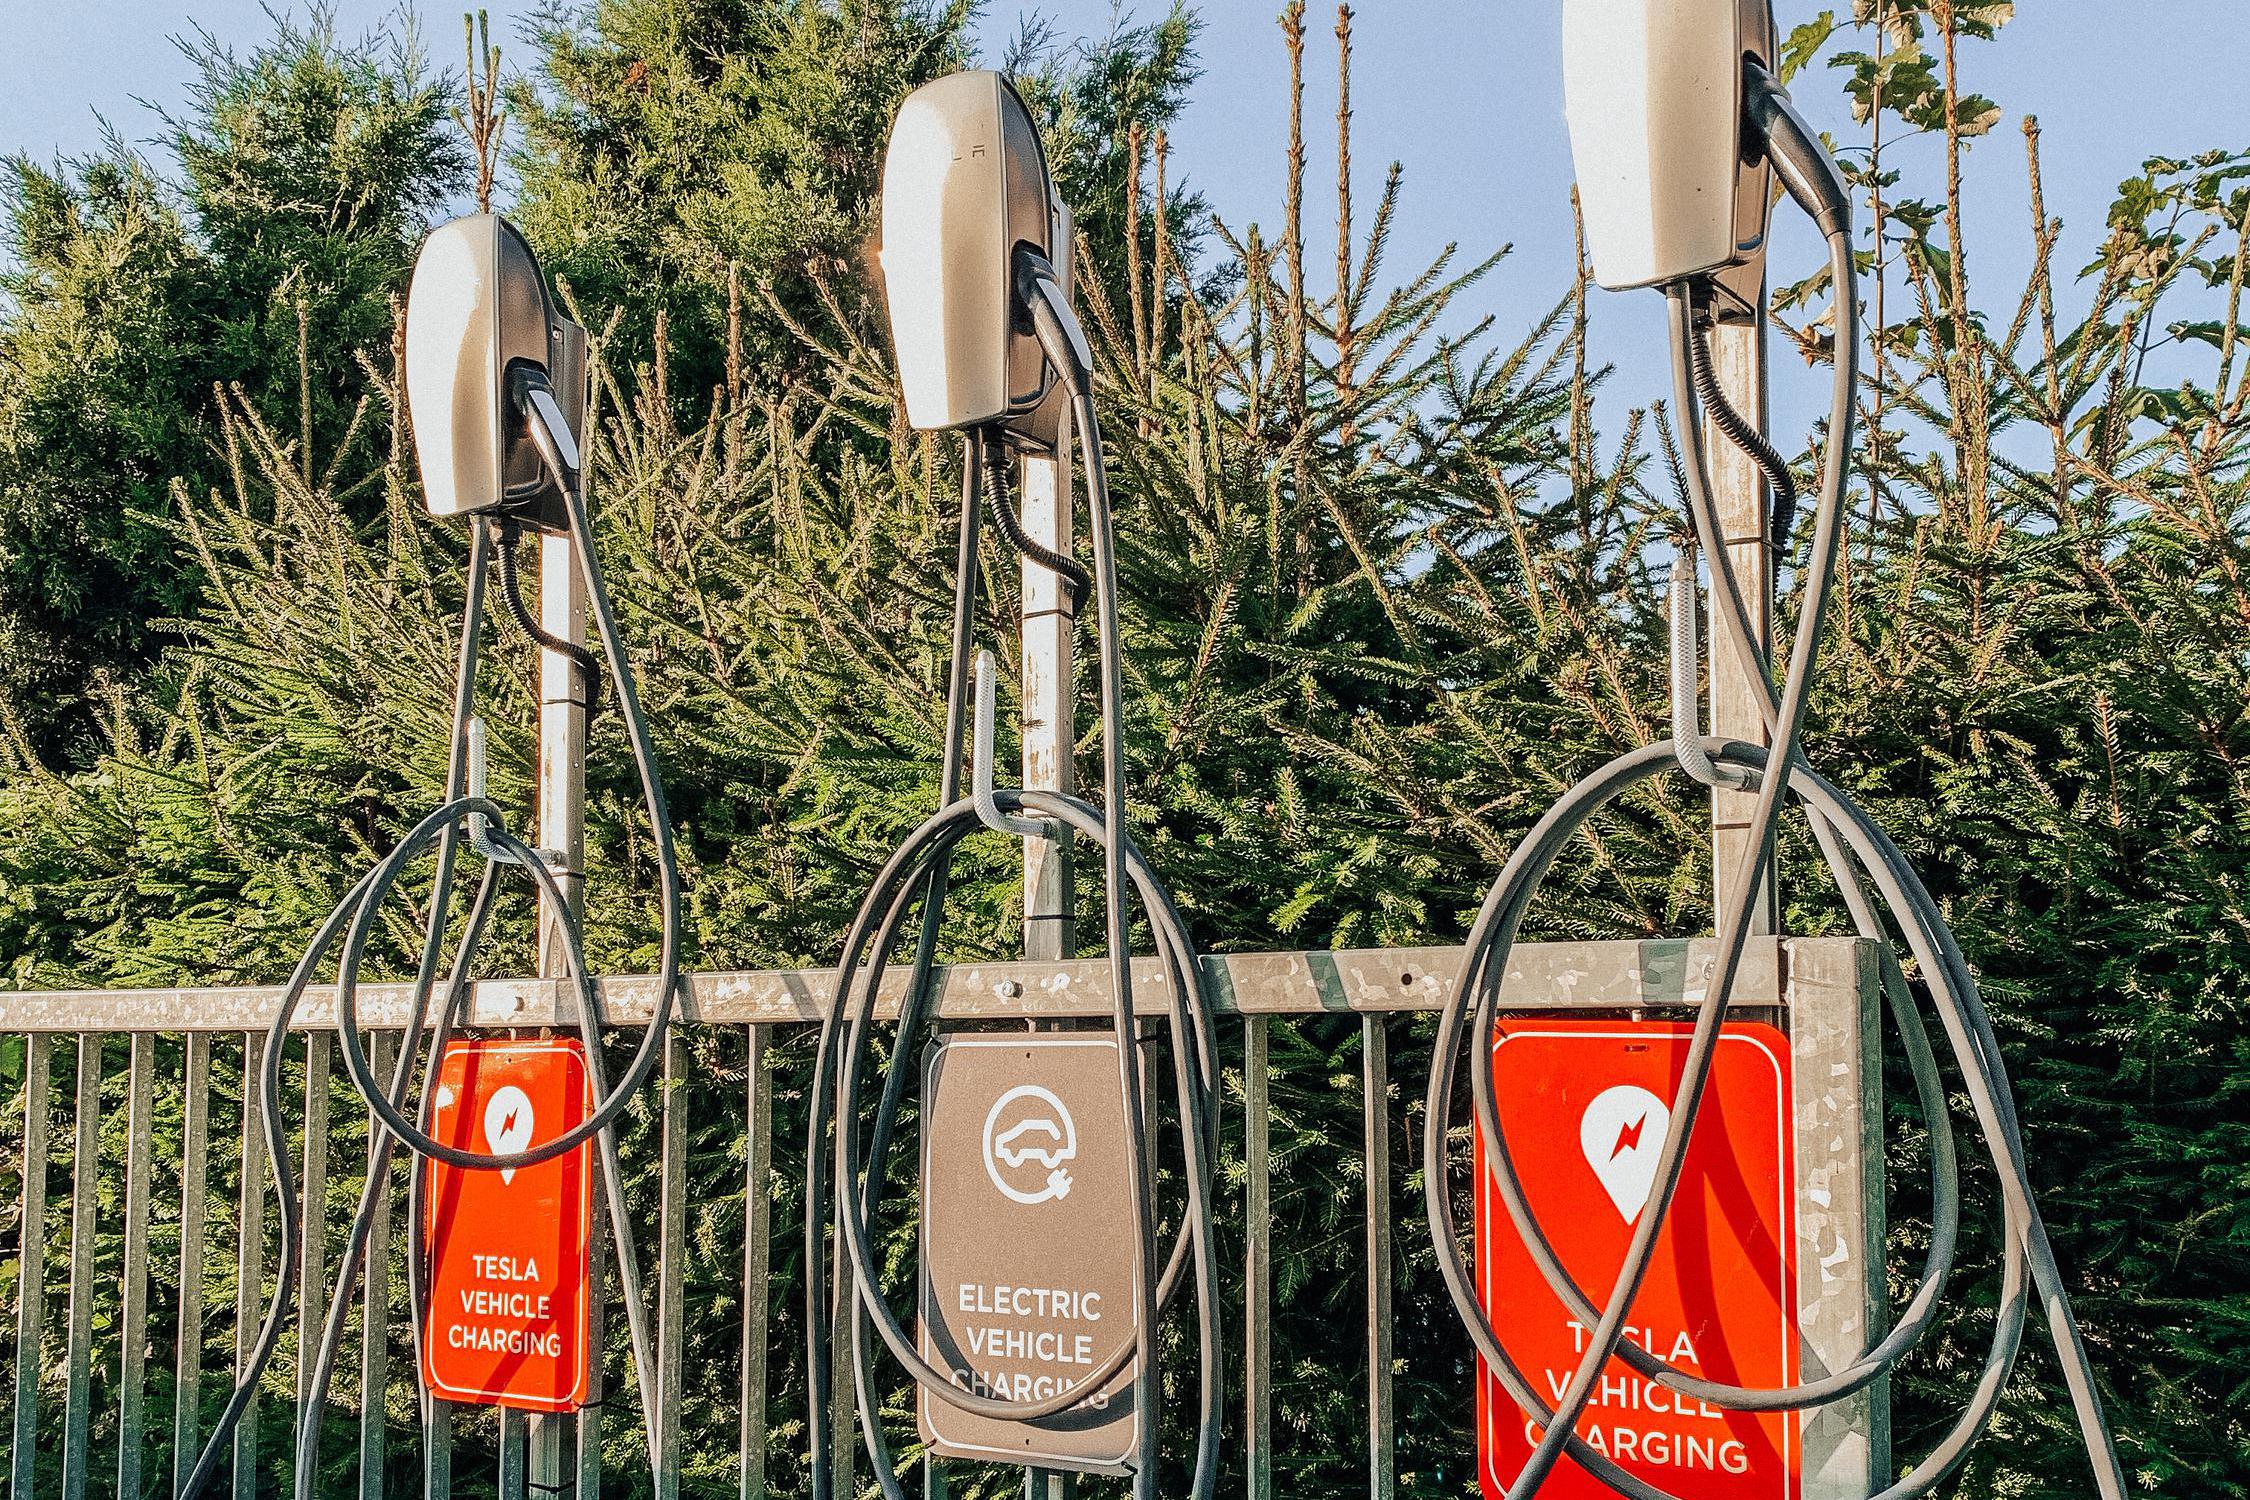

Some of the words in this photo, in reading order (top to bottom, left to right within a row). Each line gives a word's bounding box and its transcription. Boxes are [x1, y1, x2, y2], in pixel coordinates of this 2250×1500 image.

[472, 1255, 539, 1282] TESLA
[460, 1289, 551, 1320] VEHICLE
[959, 1284, 1101, 1321] ELECTRIC
[448, 1325, 562, 1358] CHARGING
[966, 1327, 1093, 1365] VEHICLE
[1566, 1321, 1699, 1365] TSLA
[1544, 1368, 1723, 1419] VHICL
[1524, 1418, 1748, 1475] CARGING
